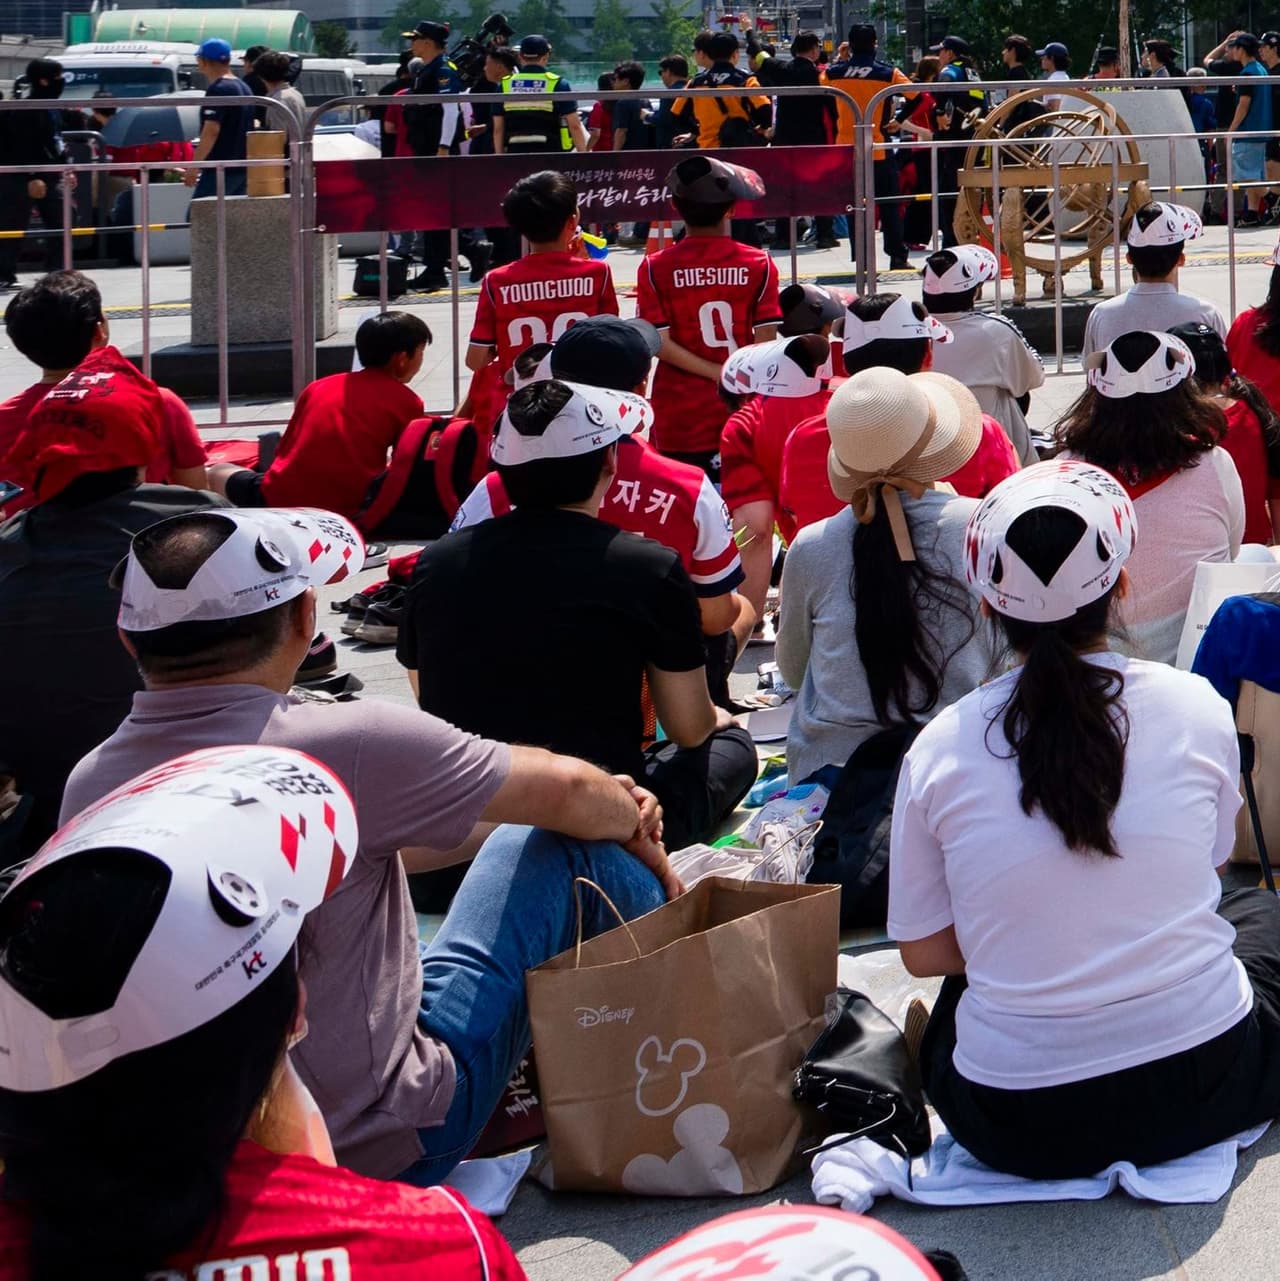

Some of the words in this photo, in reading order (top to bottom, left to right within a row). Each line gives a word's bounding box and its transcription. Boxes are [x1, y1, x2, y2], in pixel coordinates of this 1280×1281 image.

[844, 66, 873, 78] 119
[617, 168, 656, 182] 거리응원
[673, 266, 750, 288] GUESUNG
[499, 277, 595, 305] YOUNGWOO
[591, 436, 603, 446] kt
[1100, 576, 1110, 590] kt
[265, 587, 281, 603] kt
[241, 951, 268, 981] kt
